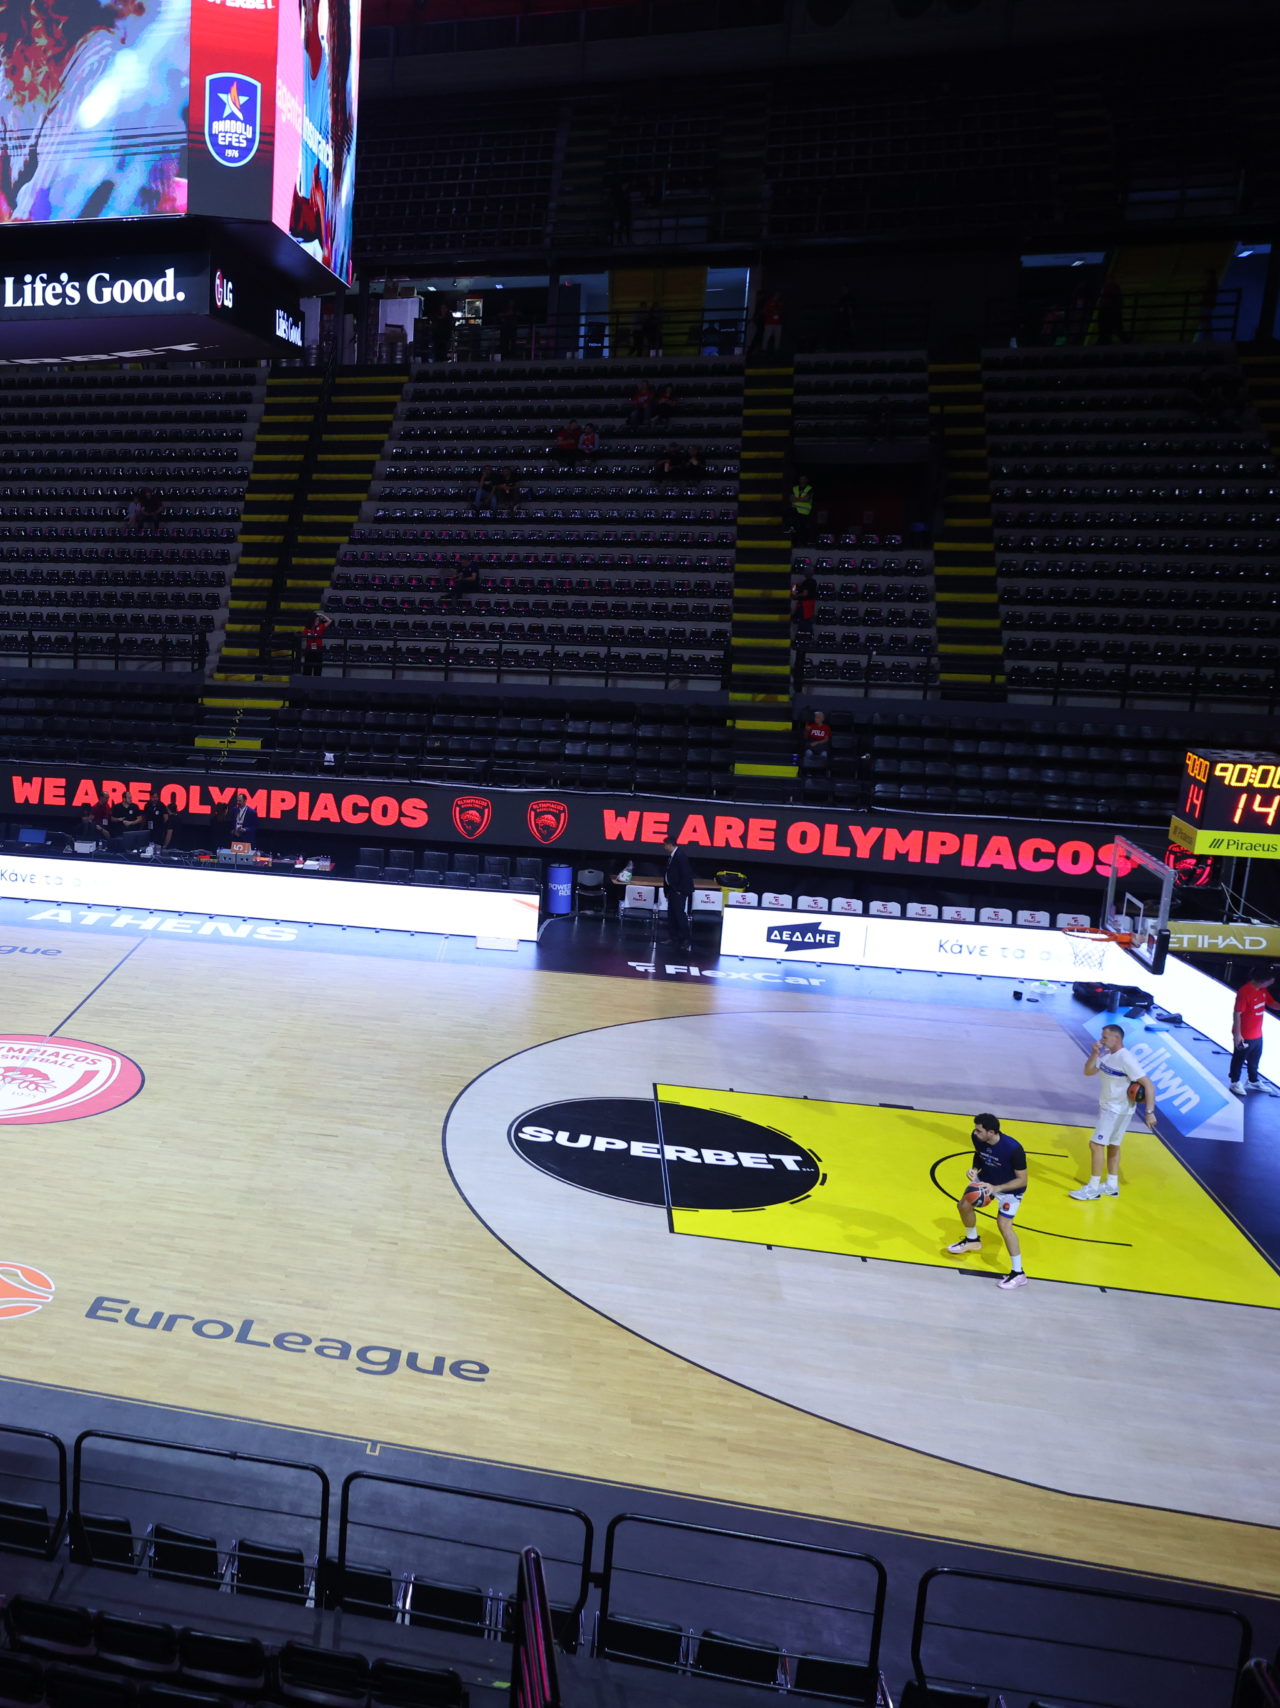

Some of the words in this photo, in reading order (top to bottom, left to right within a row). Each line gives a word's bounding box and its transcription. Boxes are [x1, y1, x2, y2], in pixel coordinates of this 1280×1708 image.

[275, 78, 303, 134] agenta
[212, 120, 253, 139] ANADOLU
[218, 132, 248, 148] EFES
[225, 149, 240, 158] 1976
[3, 272, 81, 308] Life's
[86, 267, 186, 304] Good.
[223, 278, 233, 309] LG
[1185, 751, 1210, 783] 90:00
[11, 775, 70, 806] WE
[71, 779, 152, 810] ARE
[160, 784, 429, 829] OLYMPIACOS
[1185, 783, 1204, 819] 14
[1232, 792, 1280, 827] 14
[603, 808, 670, 844] WE
[676, 814, 778, 851] ARE
[786, 821, 1133, 878] OLYMPIACOS
[1226, 838, 1279, 853] Piraeus
[27, 907, 299, 943] ATHENS
[770, 928, 837, 945] ΔΕΔΔΗΕ
[1168, 933, 1268, 950] ETIHAD
[937, 938, 990, 958] Κάνε
[665, 964, 826, 987] FlexCar
[1130, 1041, 1201, 1115] allwyn
[518, 1125, 804, 1172] SUPERBET
[85, 1294, 491, 1383] EuroLeague
